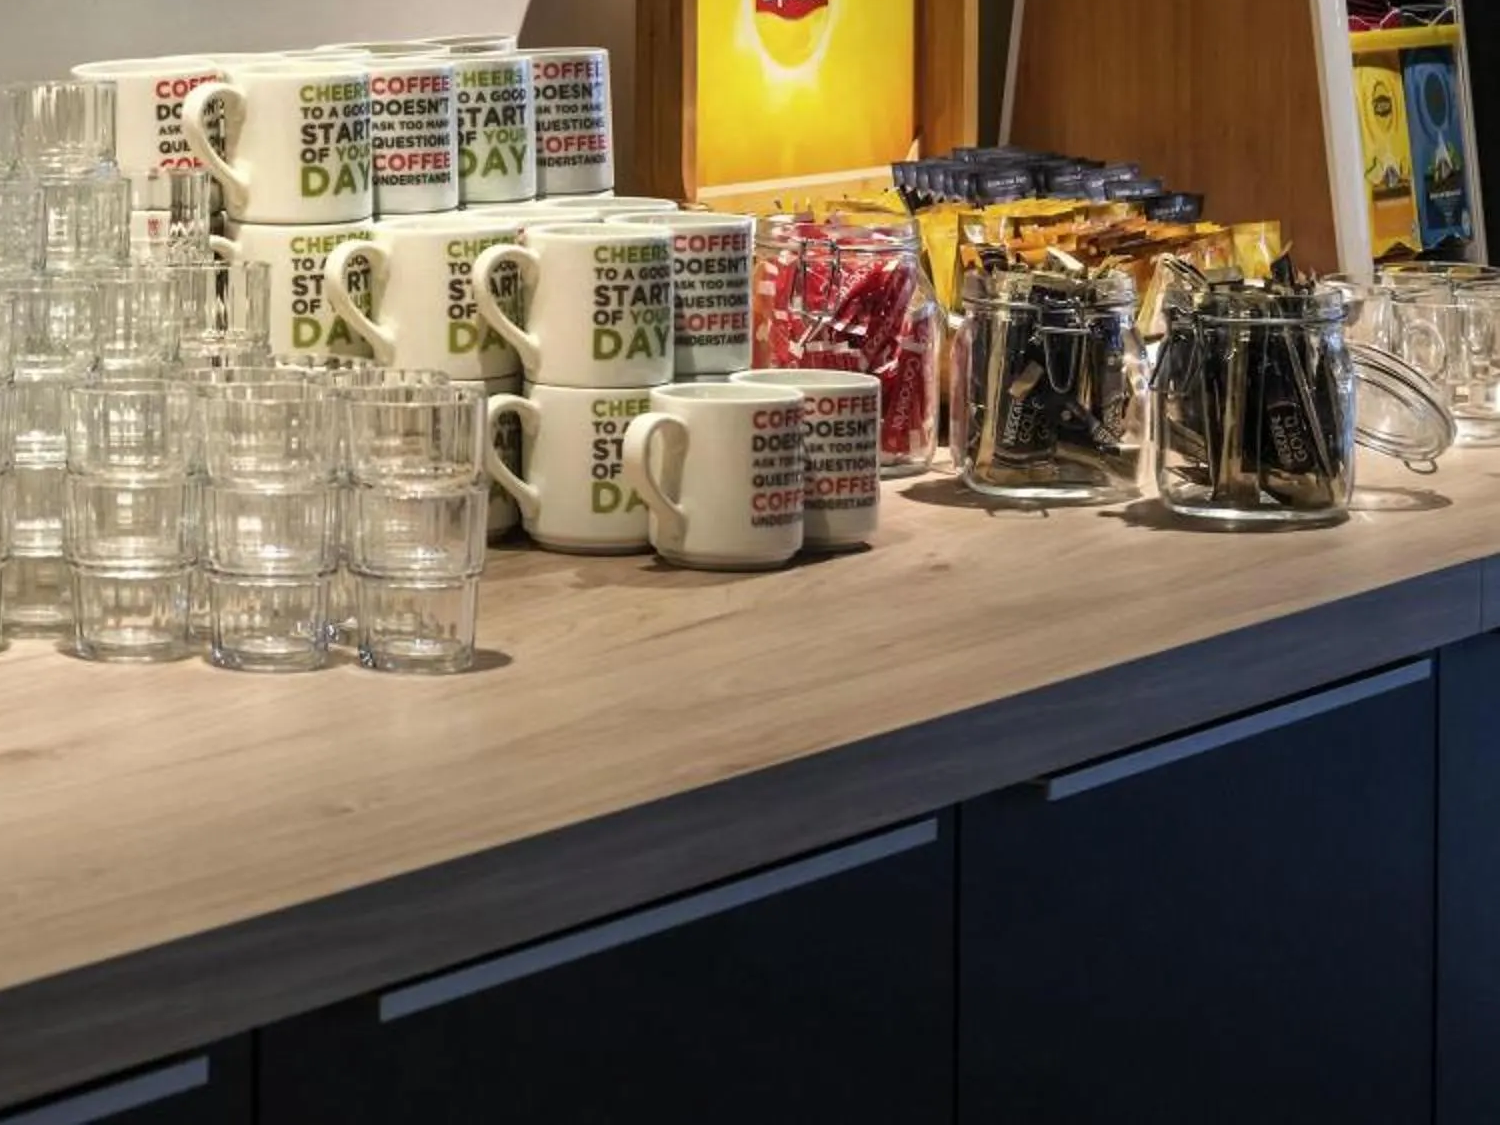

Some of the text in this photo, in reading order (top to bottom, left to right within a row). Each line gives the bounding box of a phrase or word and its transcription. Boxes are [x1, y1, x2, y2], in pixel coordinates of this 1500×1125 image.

[155, 74, 218, 99] COF
[371, 75, 451, 96] COFFEE
[371, 97, 450, 116] DOESN'T
[456, 91, 471, 104] O
[475, 91, 487, 104] A
[300, 106, 324, 120] TO
[328, 105, 339, 119] A
[555, 103, 579, 115] TOO
[300, 118, 370, 145] START
[371, 121, 396, 132] ASK
[399, 119, 423, 131] TOO
[300, 147, 331, 164] OF
[371, 151, 451, 172] COFFEE
[457, 143, 528, 179] DAY
[300, 161, 370, 198] DAY
[292, 257, 316, 271] TO
[447, 261, 472, 275] TO
[594, 266, 619, 282] TO
[623, 265, 635, 281] A
[291, 268, 371, 297] STRT
[700, 280, 725, 291] TOO
[593, 281, 670, 308] START
[291, 298, 322, 315] OF
[448, 303, 479, 320] OF
[593, 309, 623, 326] OF
[291, 313, 368, 349] DA
[448, 321, 506, 355] DA
[593, 325, 670, 361] DAY
[592, 399, 652, 418] CHEE
[592, 421, 617, 435] TO
[752, 407, 805, 430] COFF
[1001, 399, 1025, 447] NESCAF
[829, 442, 854, 453] TOO
[592, 464, 622, 480] OF
[592, 481, 650, 514] DA
[752, 488, 805, 512] COFF
